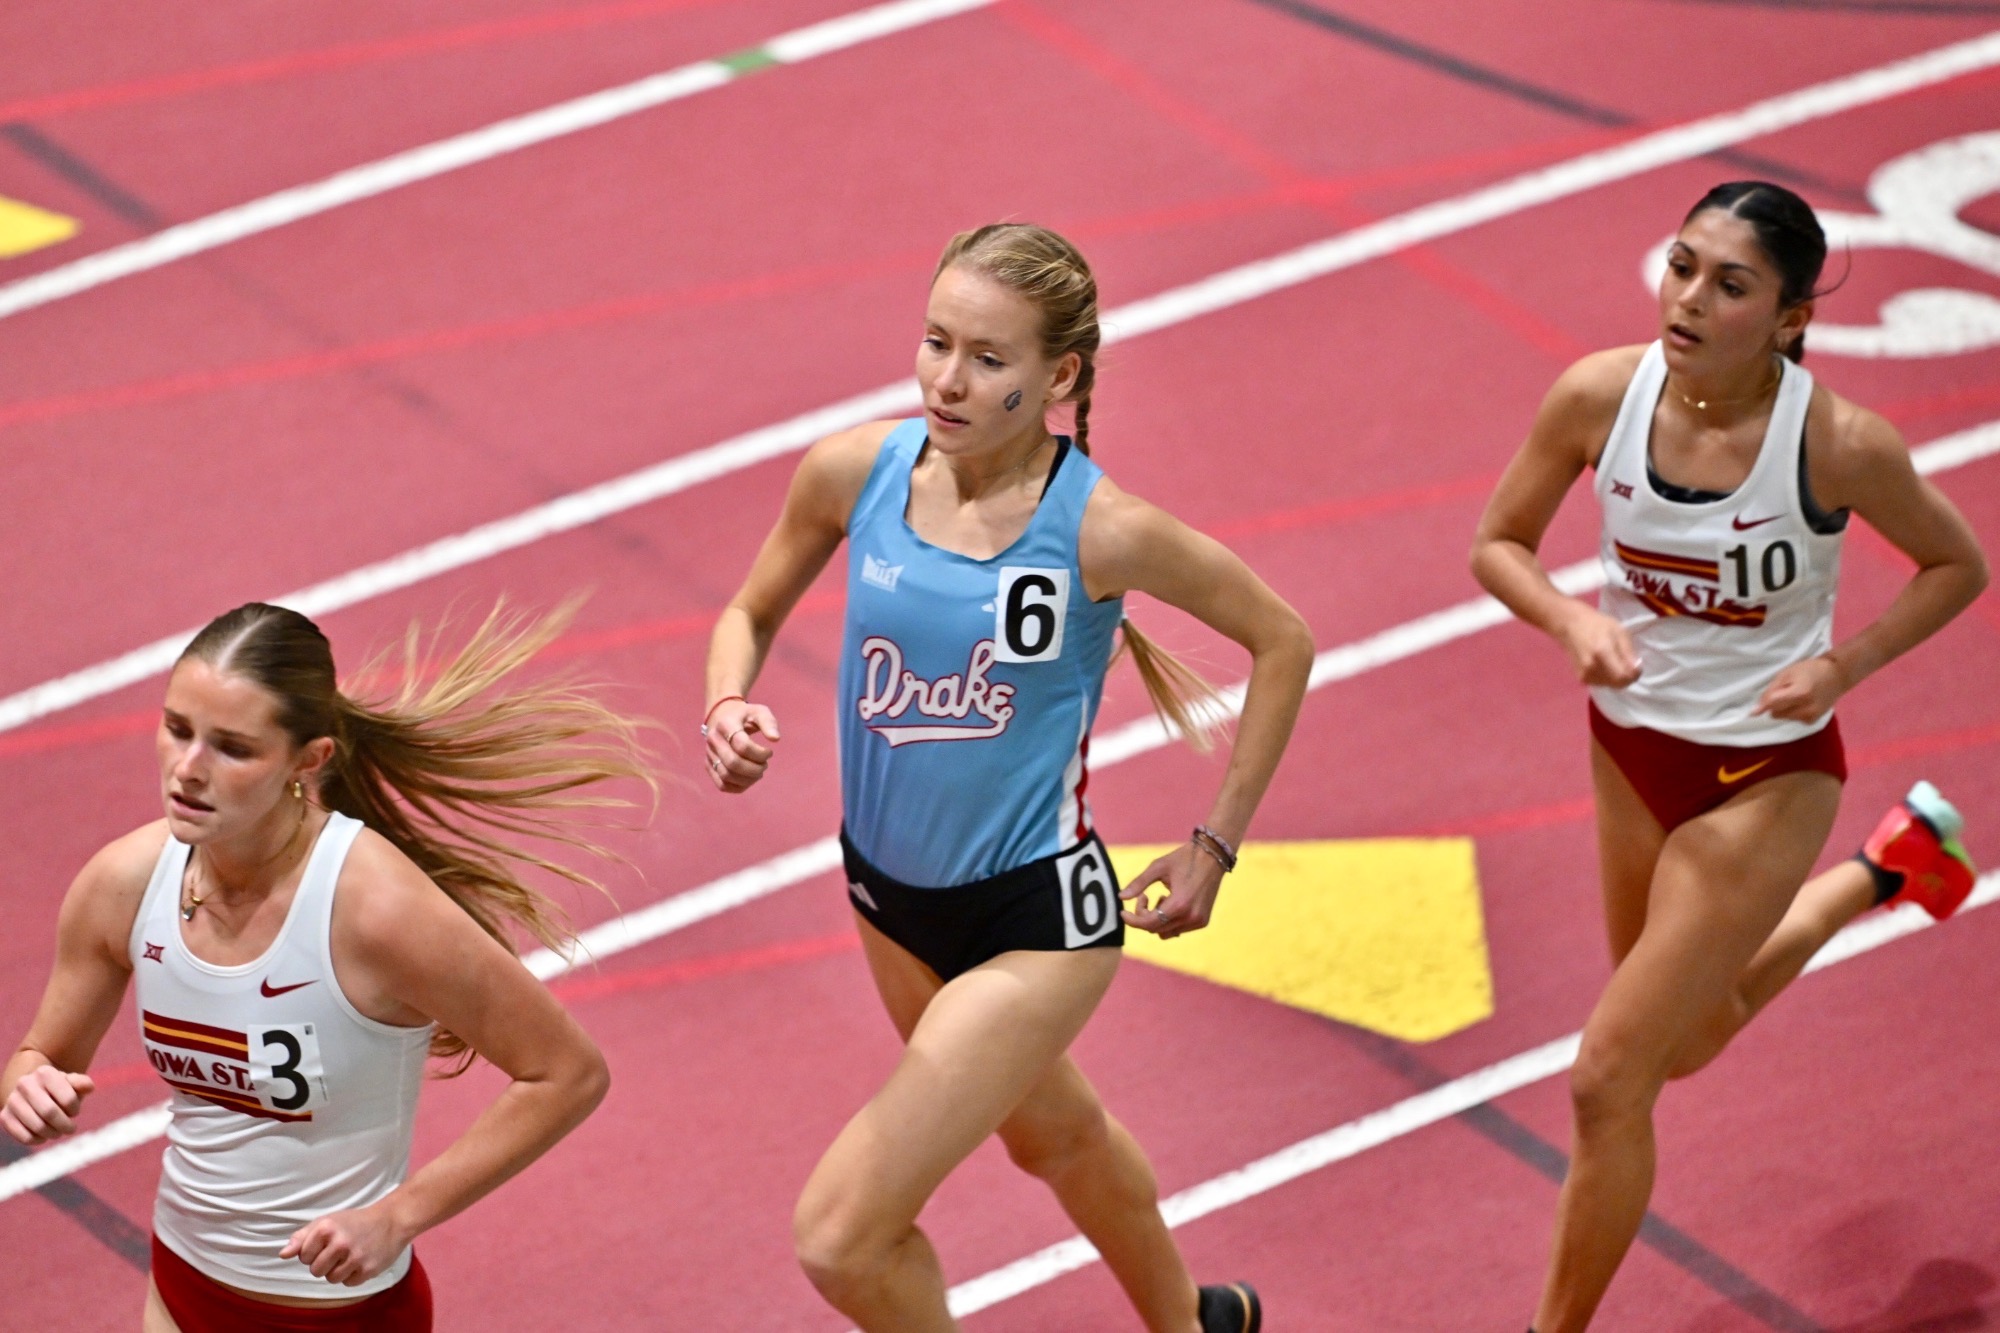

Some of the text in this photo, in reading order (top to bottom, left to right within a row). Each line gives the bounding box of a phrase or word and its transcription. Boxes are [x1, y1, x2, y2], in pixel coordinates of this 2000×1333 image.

[1725, 540, 1796, 598] 10
[1005, 574, 1057, 657] 6
[857, 635, 1017, 742] Drake
[1070, 853, 1108, 937] 6
[262, 1030, 310, 1111] 3
